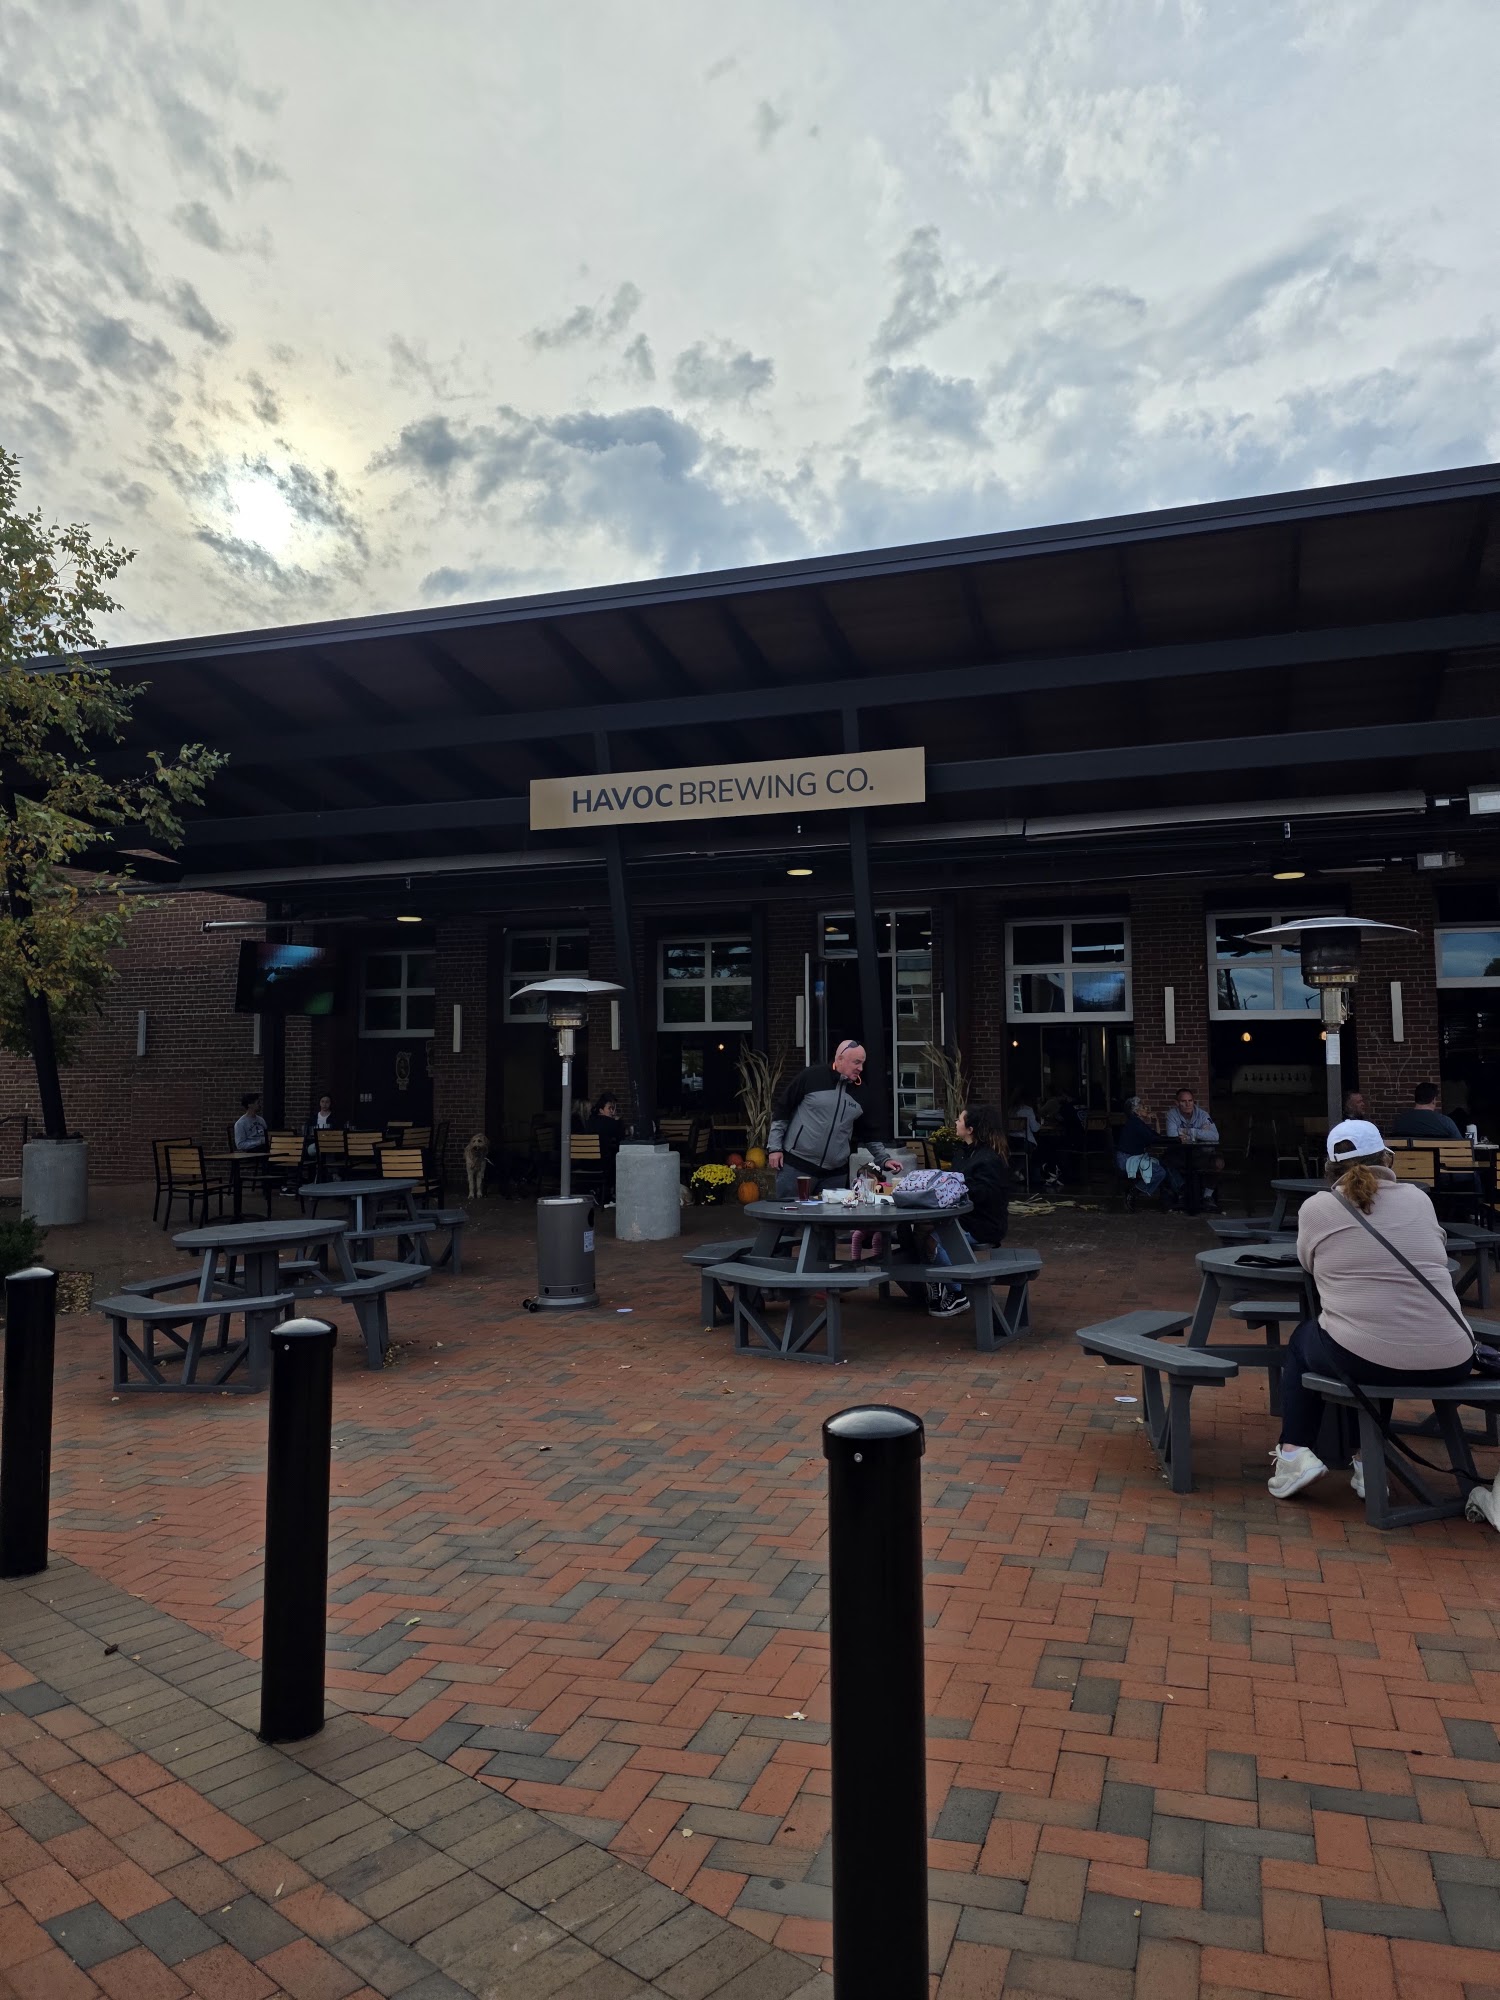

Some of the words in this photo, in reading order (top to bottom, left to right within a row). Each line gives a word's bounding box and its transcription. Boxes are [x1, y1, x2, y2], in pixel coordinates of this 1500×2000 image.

[571, 783, 674, 813] HAVOC
[679, 772, 817, 806] BREWING
[825, 767, 875, 794] CO.
